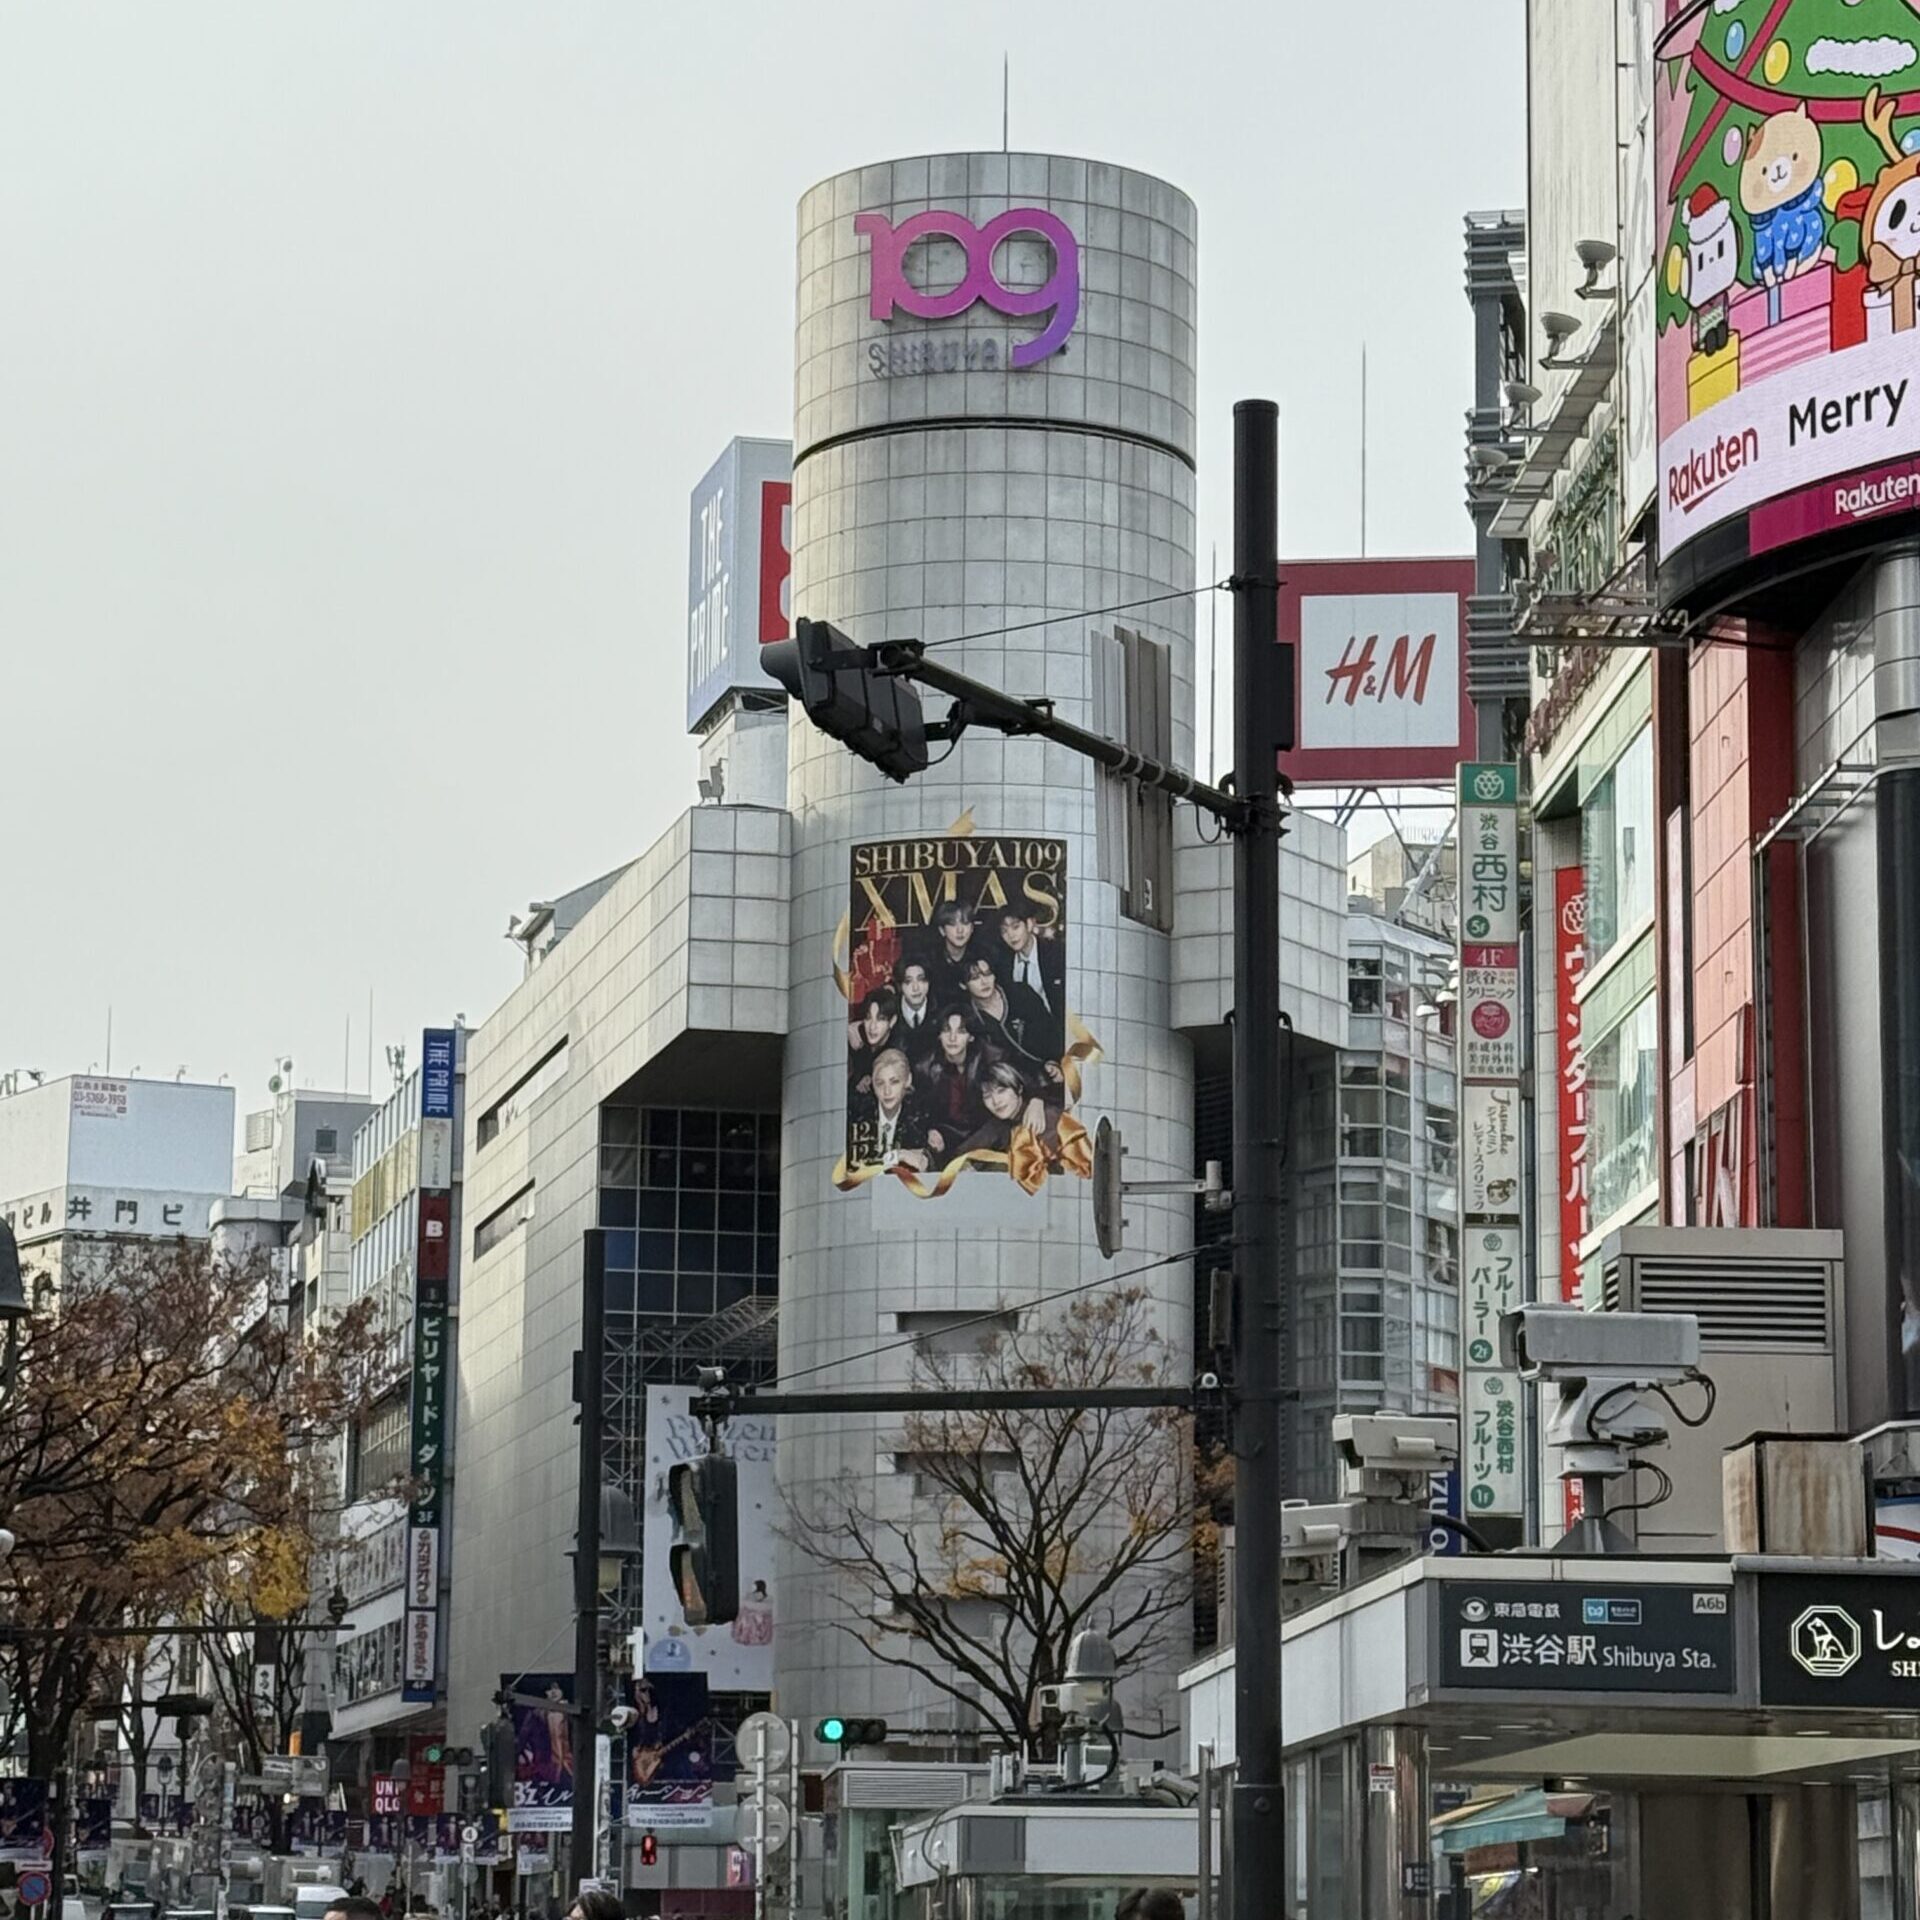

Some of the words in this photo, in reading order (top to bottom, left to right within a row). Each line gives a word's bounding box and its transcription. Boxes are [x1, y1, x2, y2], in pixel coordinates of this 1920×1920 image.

[854, 208, 1080, 368] 109
[1669, 427, 1759, 512] Rakuten
[1789, 379, 1909, 447] Merry
[1834, 473, 1920, 515] Rakuten
[1325, 634, 1437, 706] H&M
[854, 840, 1062, 875] SHIBUYA109
[1472, 812, 1508, 912] 渋谷西村
[854, 868, 1064, 932] XMAS
[1477, 948, 1504, 967] 4F
[1466, 969, 1497, 985] 渋谷
[1466, 986, 1516, 999] クリニック
[429, 1041, 450, 1065] THE
[427, 1070, 449, 1113] PRIME
[1486, 1105, 1497, 1155] ジャスミン
[67, 1196, 209, 1228] 井門ビ
[425, 1220, 444, 1237] B
[1470, 1266, 1491, 1336] パーラー
[1472, 1410, 1493, 1481] フルーツ
[1496, 1400, 1515, 1475] 渋谷西村
[418, 1510, 434, 1523] 3F
[1493, 1602, 1561, 1619] 東急電鉄
[1696, 1597, 1725, 1610] A6b
[1501, 1632, 1598, 1666] 渋谷駅
[1602, 1645, 1676, 1673] Shibuya
[1681, 1647, 1717, 1669] Sta.
